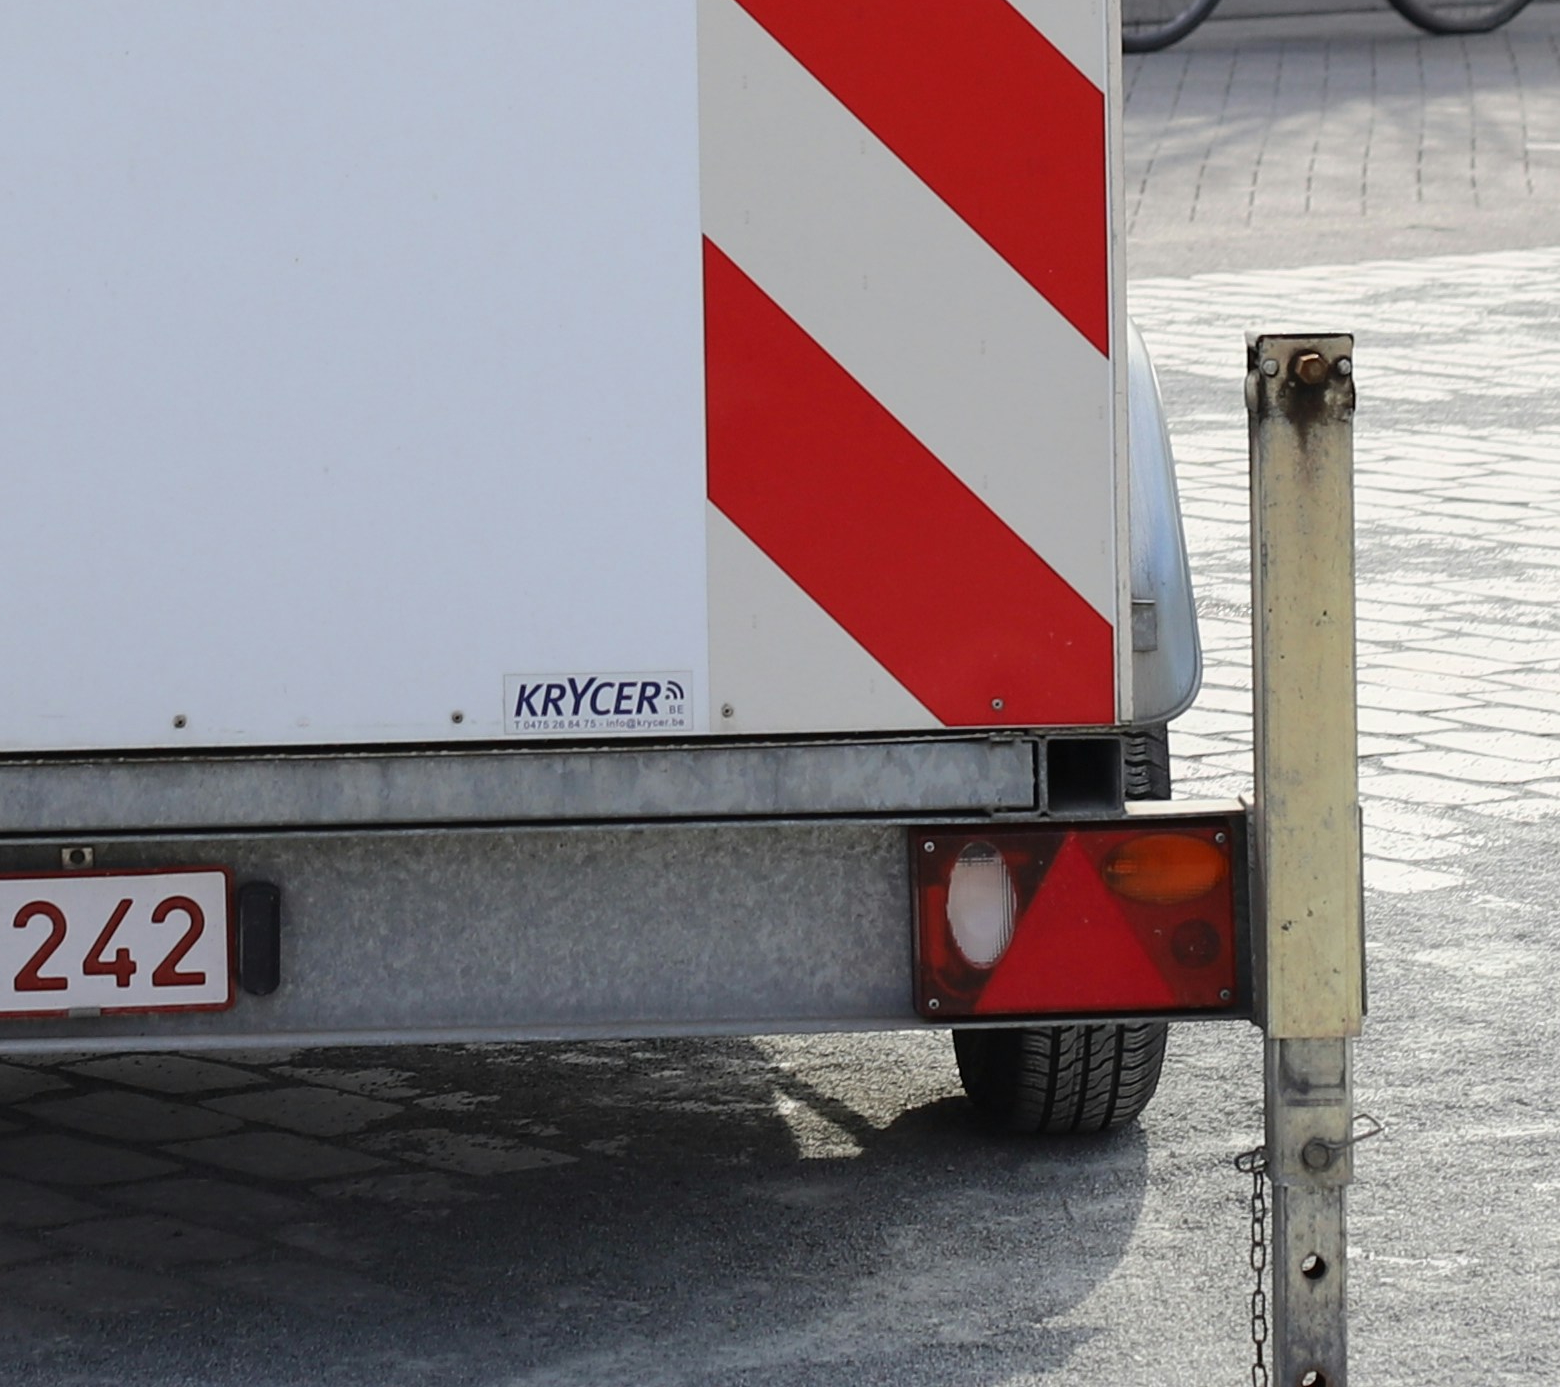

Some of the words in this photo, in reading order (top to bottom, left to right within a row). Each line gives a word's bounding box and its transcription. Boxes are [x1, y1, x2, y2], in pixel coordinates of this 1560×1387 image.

[514, 677, 662, 718] KRYCER
[668, 704, 685, 715] BE
[523, 720, 550, 730] 0475
[552, 720, 565, 729] 26
[568, 719, 581, 729] 84
[583, 719, 597, 728] 75
[606, 717, 685, 730] info@krycer.be
